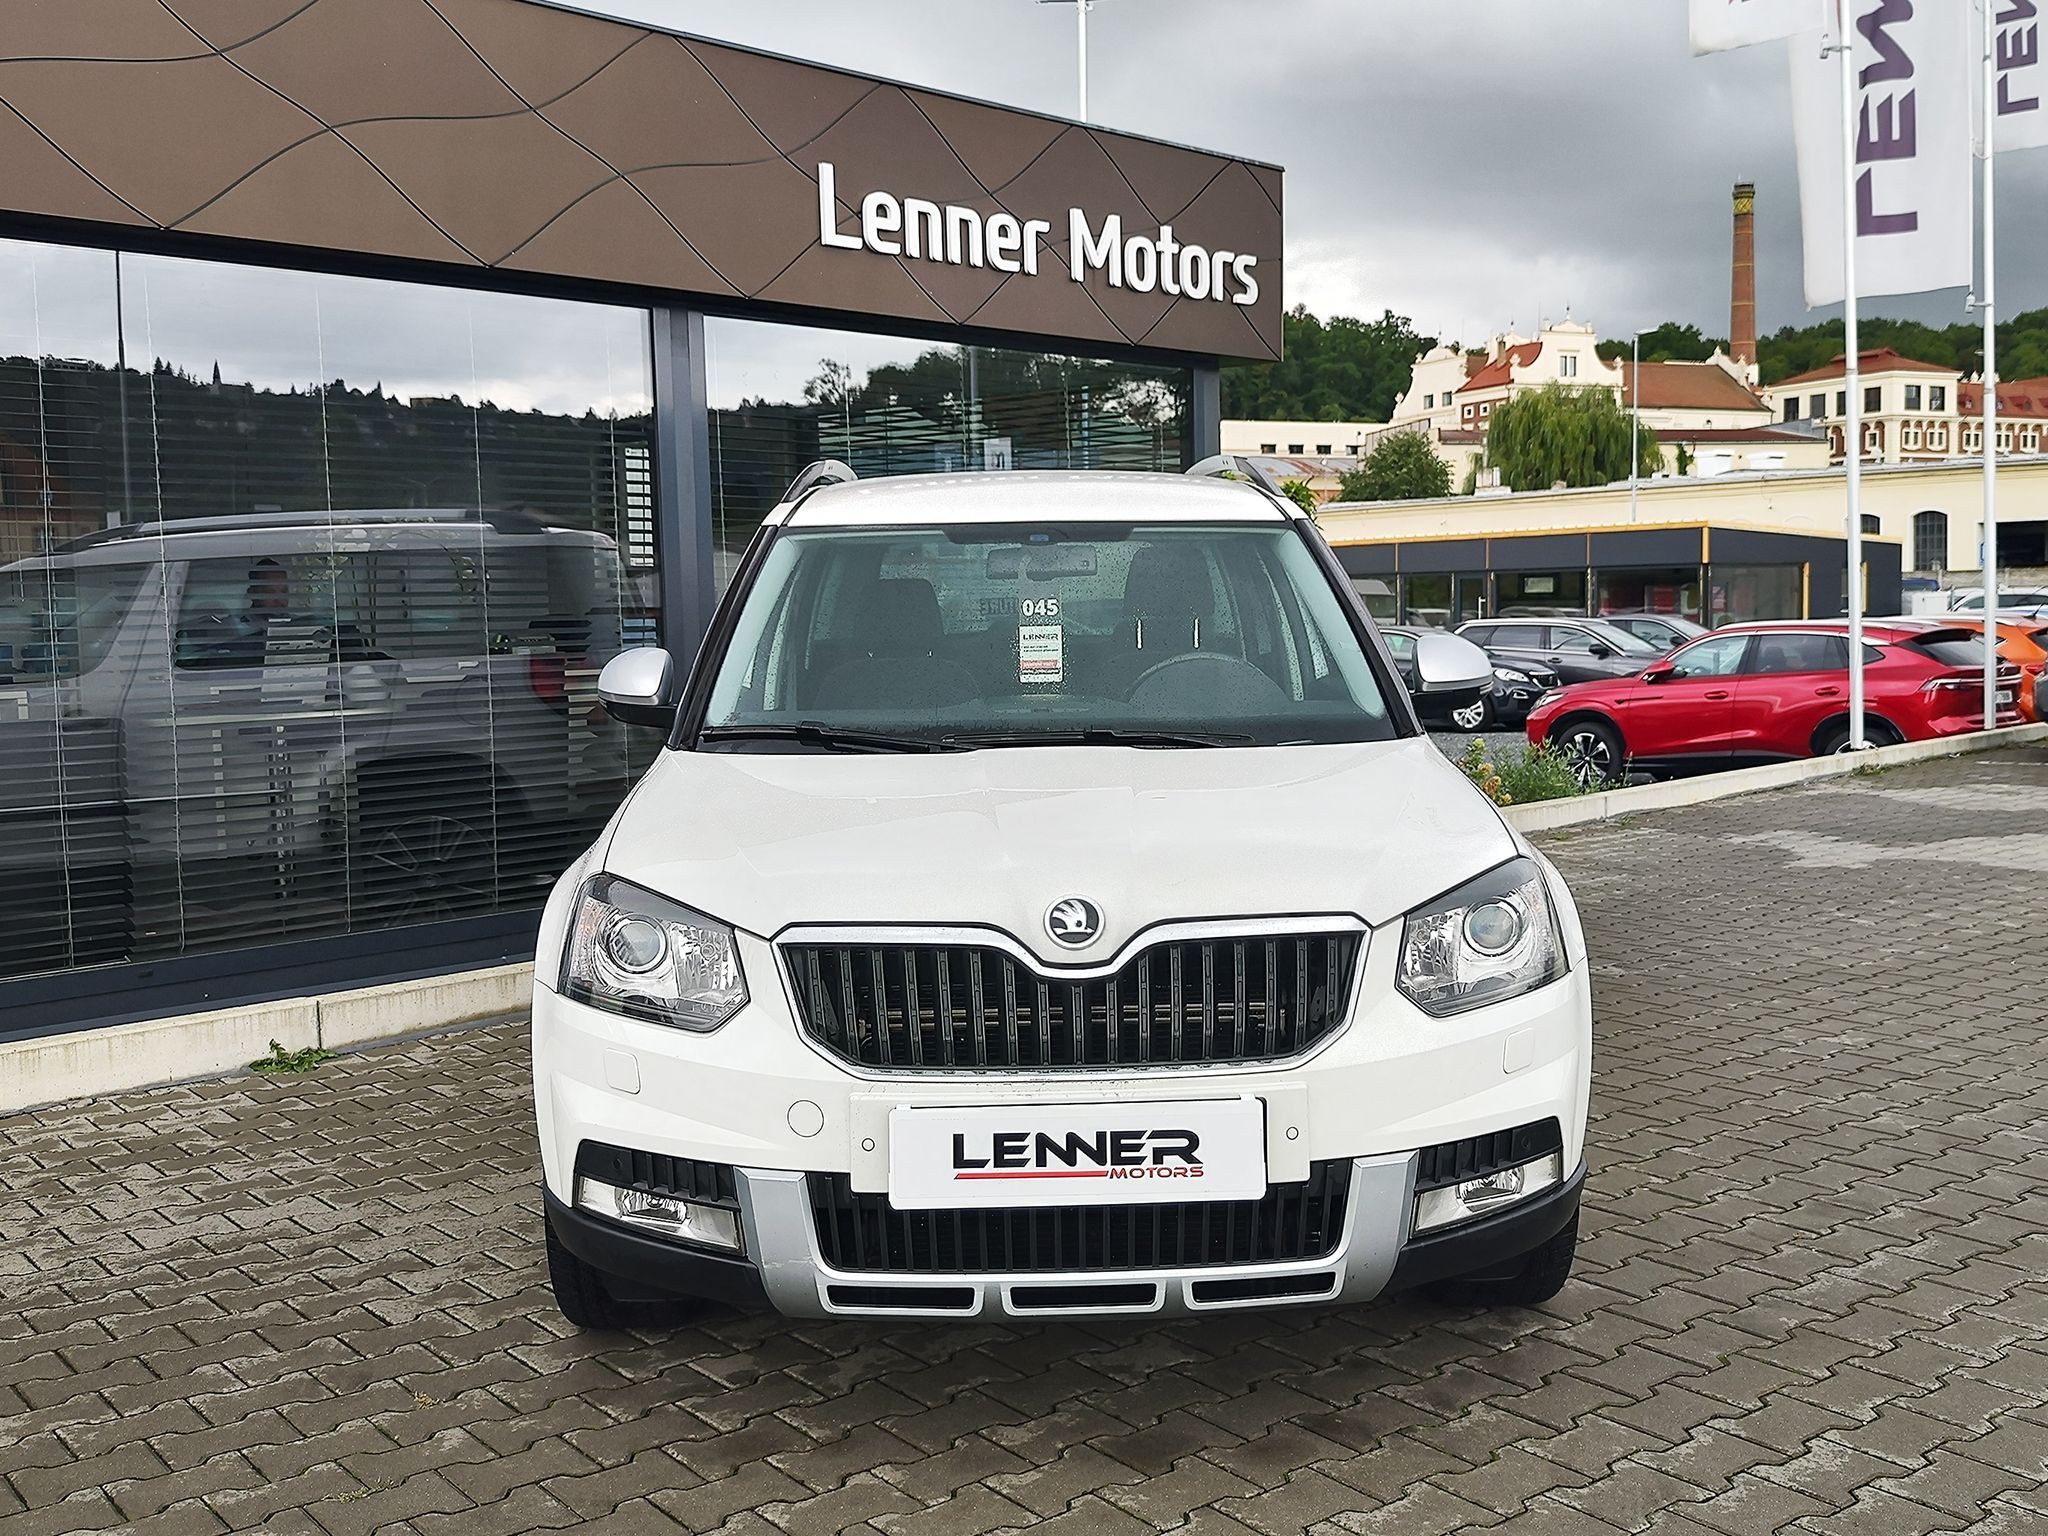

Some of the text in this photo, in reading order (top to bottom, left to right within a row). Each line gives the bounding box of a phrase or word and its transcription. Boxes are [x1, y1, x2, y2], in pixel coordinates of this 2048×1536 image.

[818, 161, 1259, 305] Lenner Motors
[1021, 598, 1060, 617] 045
[952, 1129, 1204, 1168] LENNER
[1110, 1166, 1204, 1180] MOTORS
